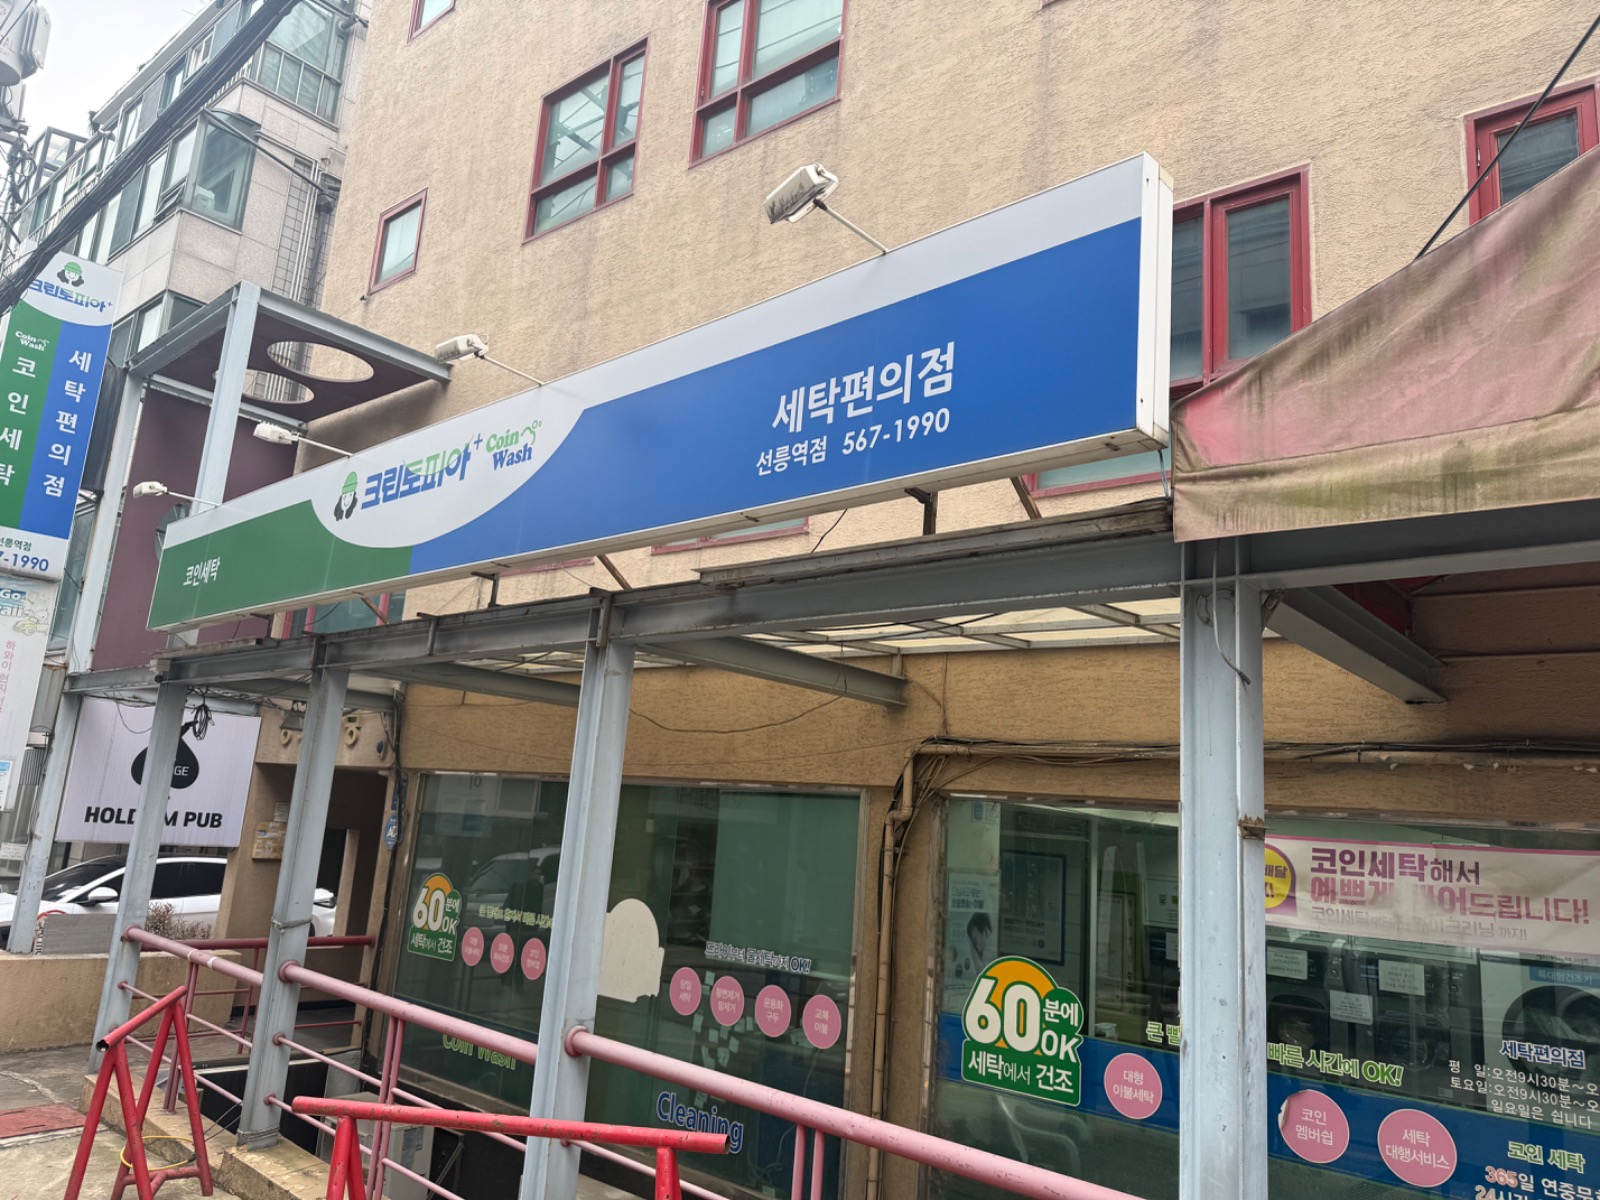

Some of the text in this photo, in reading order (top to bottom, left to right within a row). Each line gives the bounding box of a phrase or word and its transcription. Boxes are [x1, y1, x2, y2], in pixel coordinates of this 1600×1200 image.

[772, 341, 955, 433] 세탁편의점
[486, 429, 519, 453] Coin
[756, 408, 950, 476] 선릉역점 567-1990
[492, 443, 533, 471] Wash
[183, 556, 221, 587] 코인세탁
[174, 765, 190, 776] GE
[84, 806, 223, 829] HOLM PUB
[1311, 847, 1480, 885] 코인세탁해서
[412, 887, 446, 931] 60
[442, 916, 458, 935] OK
[790, 956, 811, 974] OK!
[965, 977, 1079, 1052] 60 분에
[1041, 1029, 1079, 1063] OK
[1146, 1020, 1180, 1046] 큰 빨
[1267, 1042, 1404, 1087] 빠른 시간에 OK!
[1499, 1040, 1586, 1070] 세탁편의점
[967, 1050, 1074, 1093] 세탁에서 건조
[1123, 1070, 1144, 1086] 대형
[1113, 1084, 1154, 1104] 이불세탁
[657, 1090, 744, 1154] Cleaning
[1301, 1107, 1327, 1126] 코인
[1491, 1099, 1544, 1120] 일요일은
[1295, 1125, 1333, 1146] 멤버쉽
[1402, 1128, 1431, 1148] 세탁
[1385, 1144, 1451, 1170] 대행서비스
[1508, 1141, 1585, 1174] 코인 세탁
[1485, 1165, 1600, 1200] 365일 연중무
